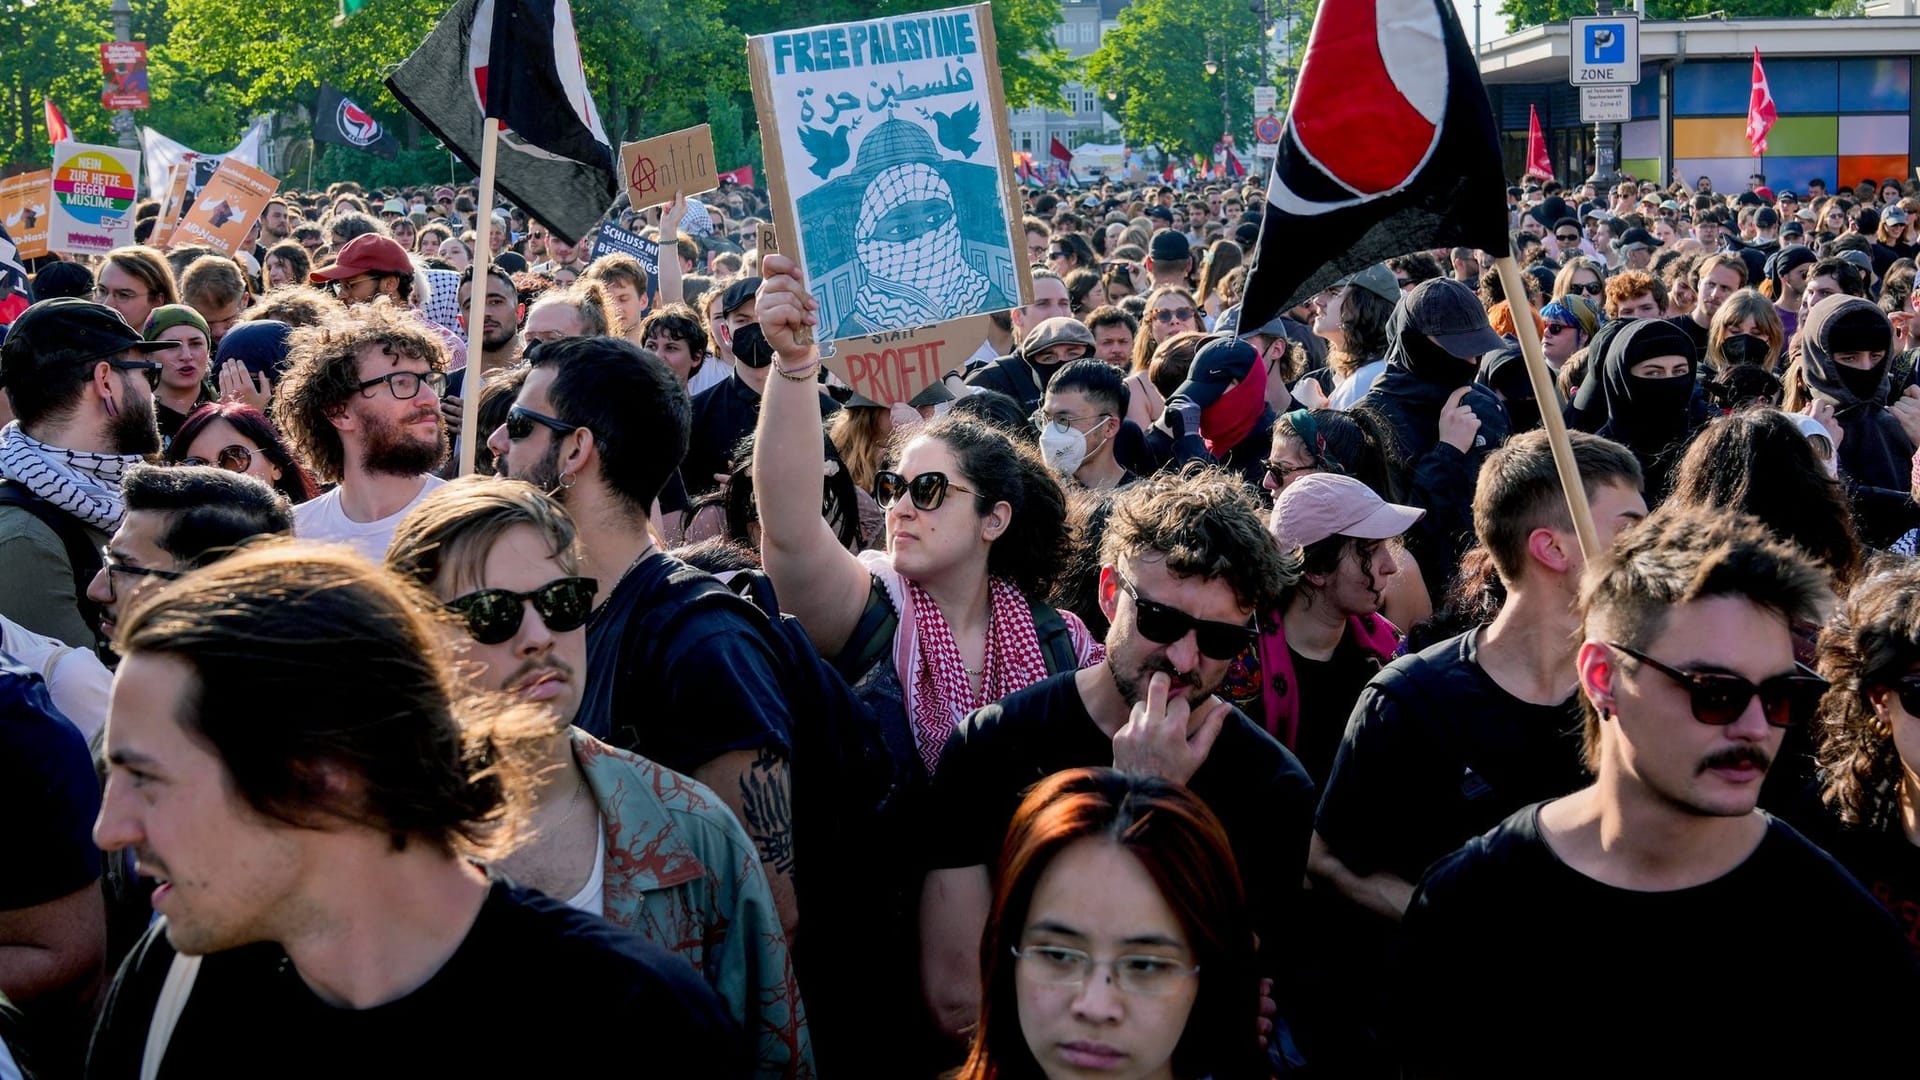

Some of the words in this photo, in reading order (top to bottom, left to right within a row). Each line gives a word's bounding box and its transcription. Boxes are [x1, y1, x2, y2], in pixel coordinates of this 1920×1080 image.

[867, 55, 974, 113] فلسطين
[1581, 68, 1615, 80] ZONE
[796, 86, 861, 125] حرة
[78, 157, 102, 170] NEIN
[631, 136, 706, 198] Antifa
[69, 169, 89, 183] ZUR
[92, 172, 120, 187] HETZE
[66, 193, 114, 209] MUSLIME
[74, 183, 105, 197] GEGEN
[603, 224, 645, 250] SCHLUSS
[845, 340, 946, 404] PROFIT
